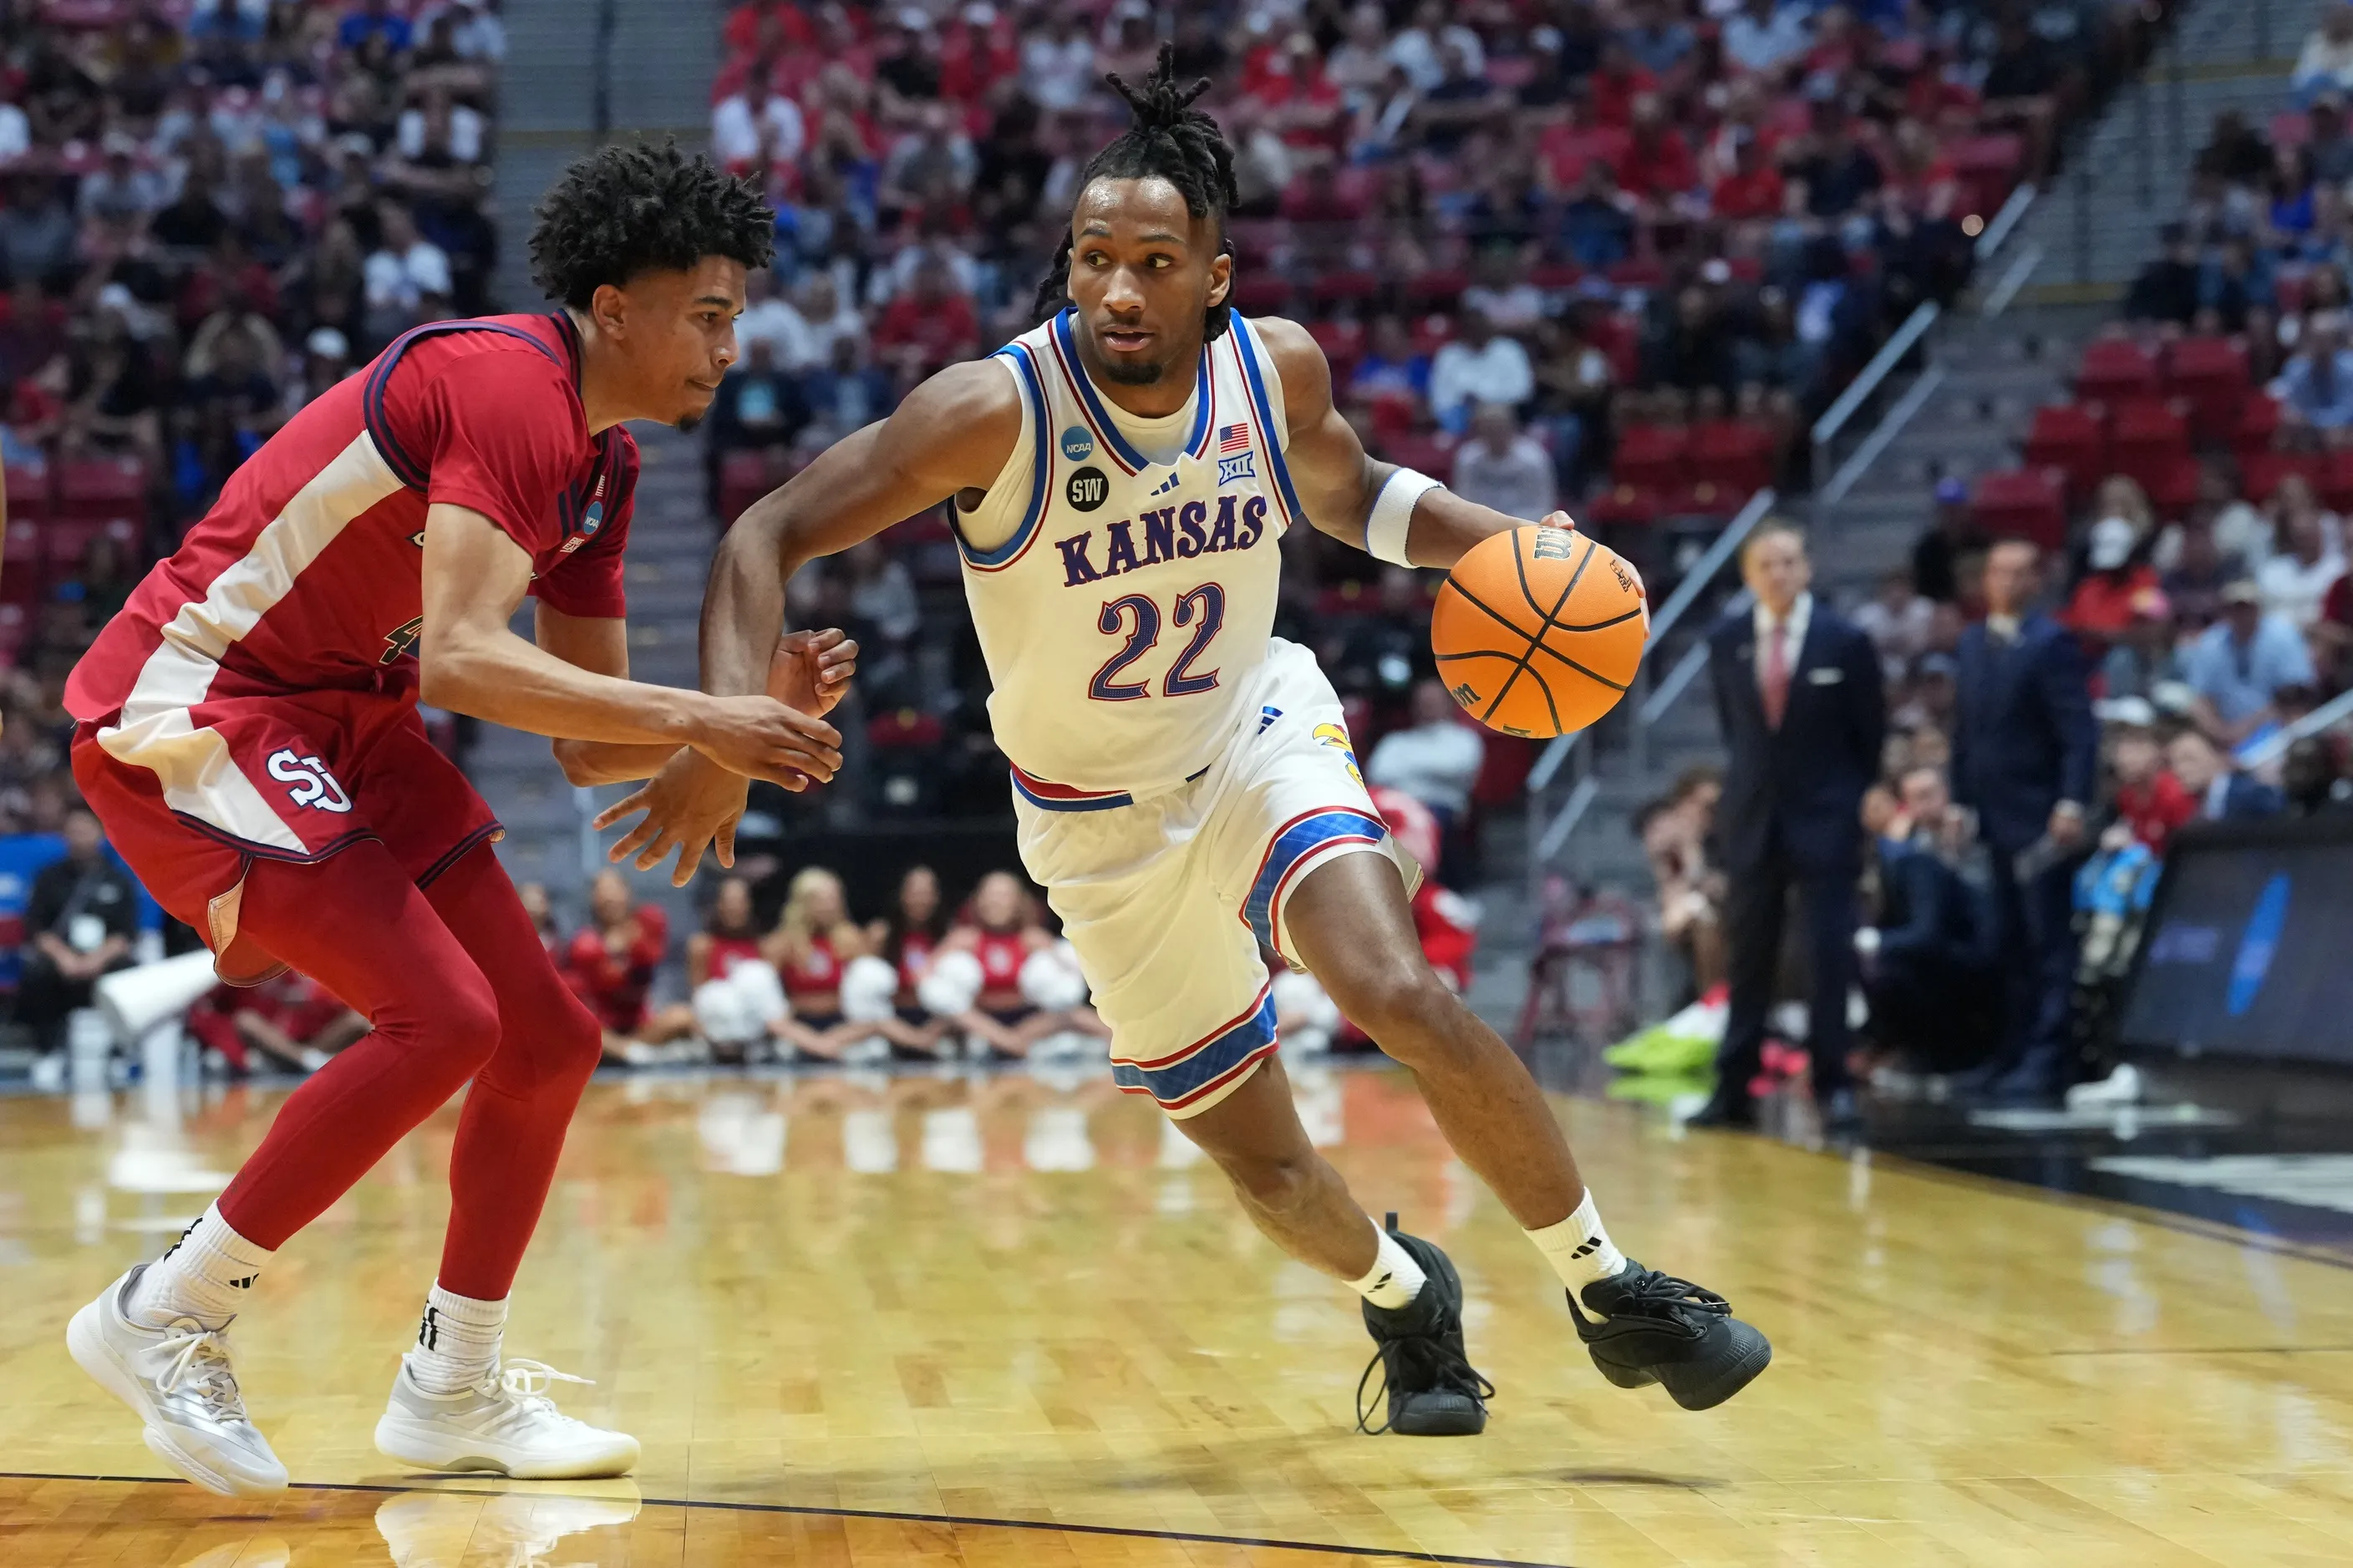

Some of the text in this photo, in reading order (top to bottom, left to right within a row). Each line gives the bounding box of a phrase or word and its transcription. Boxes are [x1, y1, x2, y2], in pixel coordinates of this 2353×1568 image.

[1066, 442, 1091, 454] NCAA
[1072, 477, 1103, 503] SW
[585, 515, 599, 529] NCAA
[1055, 495, 1268, 588] KANSAS
[1088, 581, 1226, 702] 22
